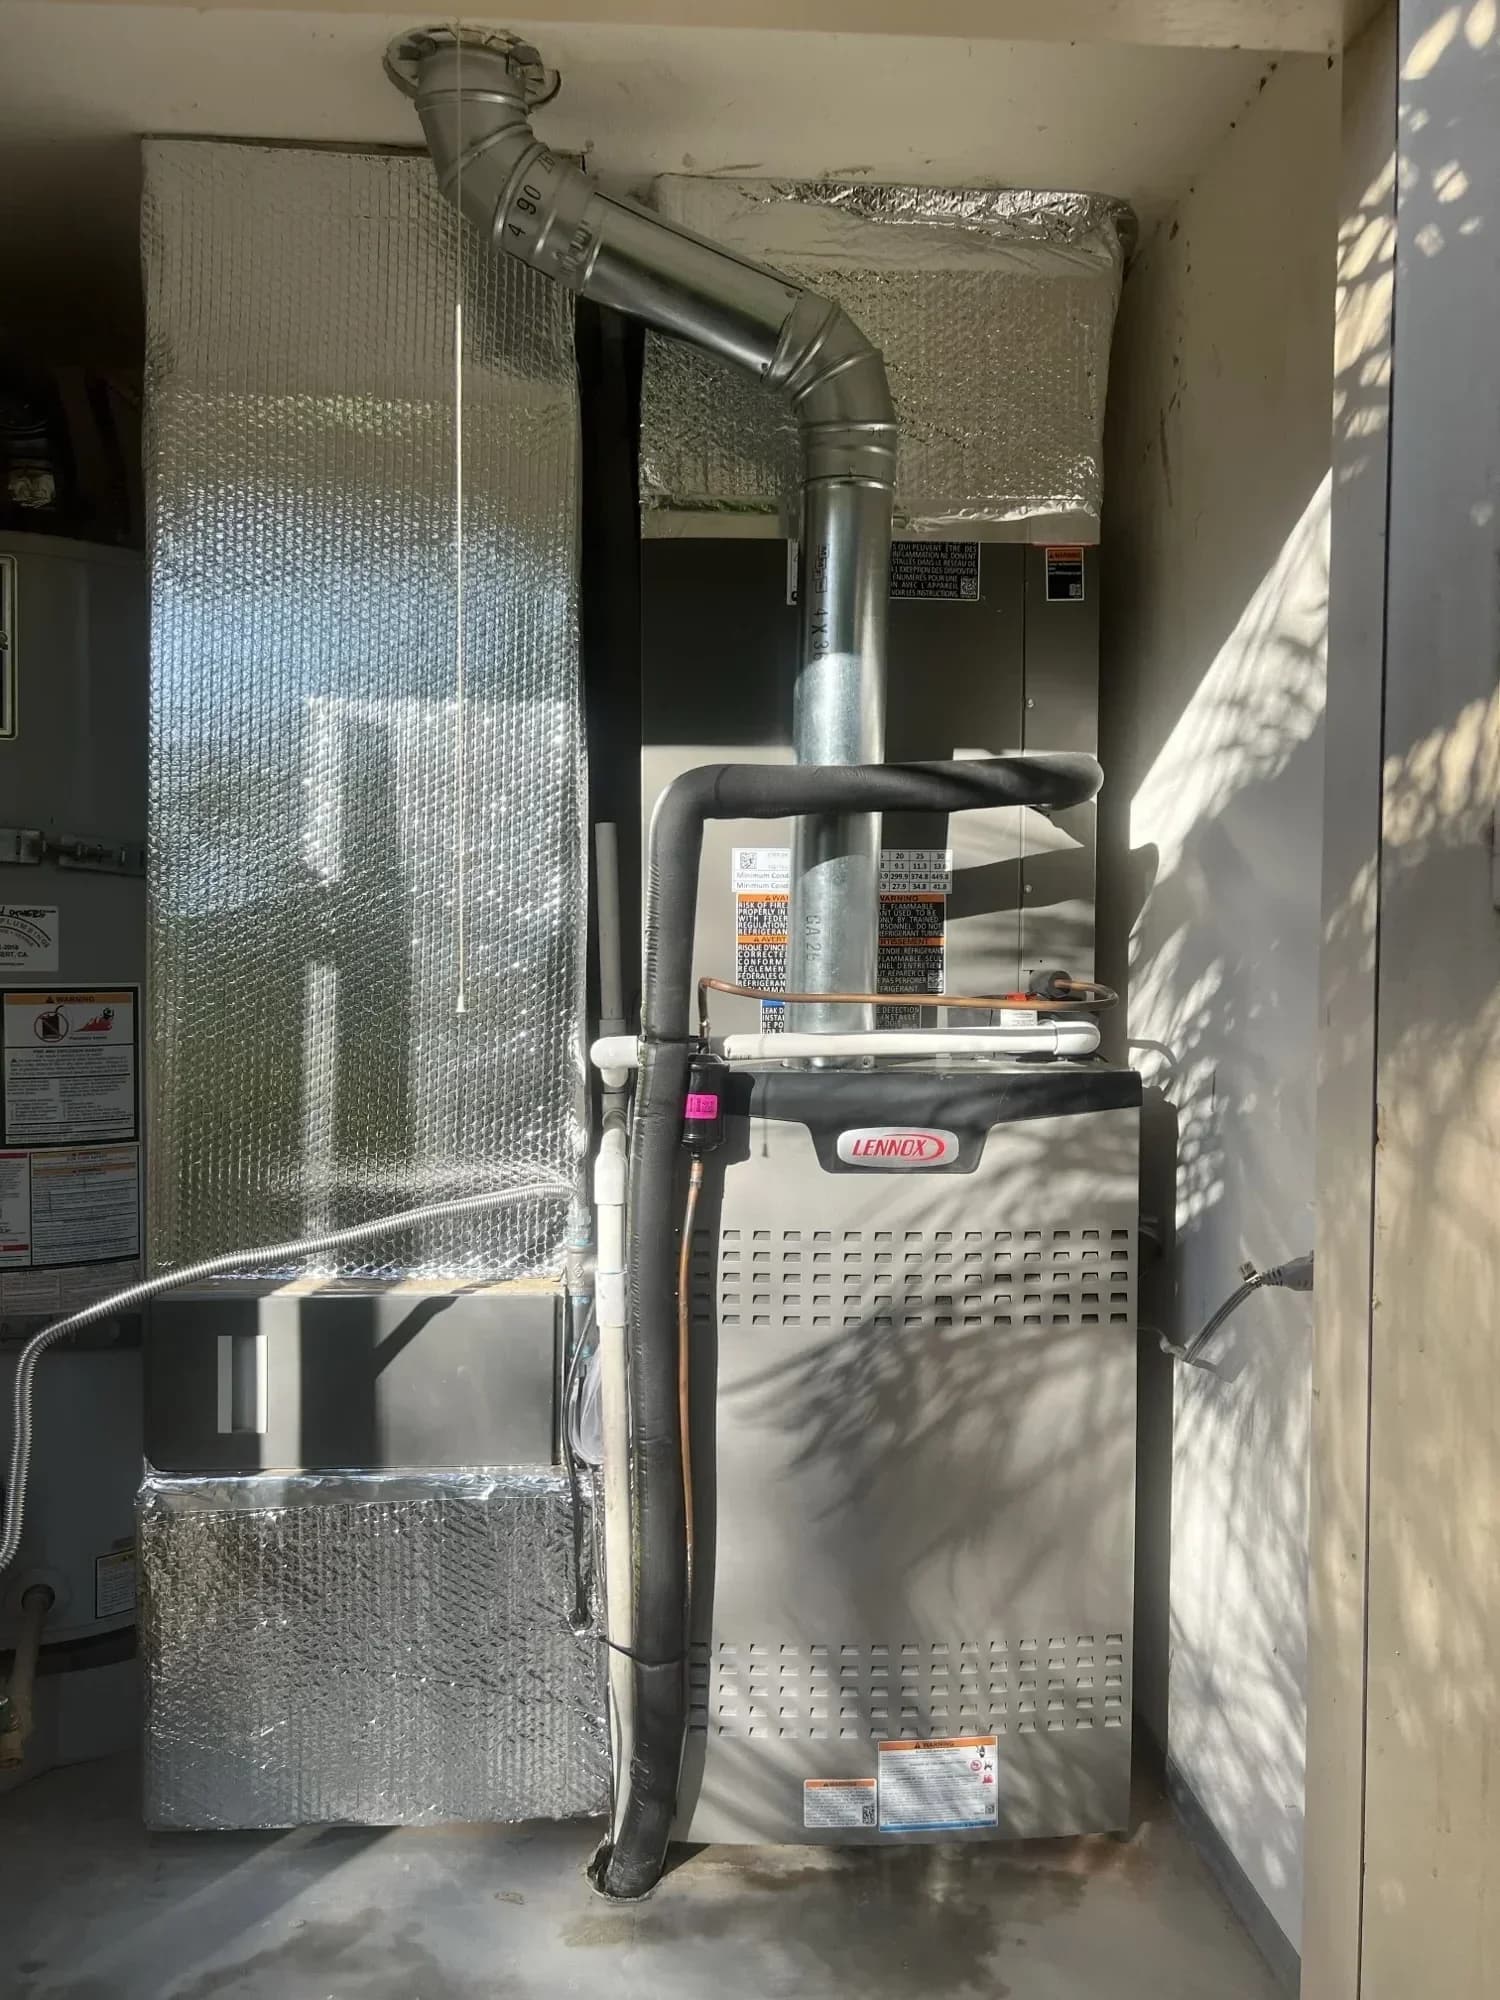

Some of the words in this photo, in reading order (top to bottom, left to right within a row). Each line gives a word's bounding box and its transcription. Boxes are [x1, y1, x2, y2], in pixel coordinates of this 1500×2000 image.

[516, 184, 542, 215] 90
[508, 223, 526, 237] 4
[814, 608, 828, 616] 4
[896, 852, 904, 860] 20
[738, 908, 776, 916] PROPERLY
[56, 995, 95, 1003] WARNING
[852, 1139, 928, 1156] LENNOX
